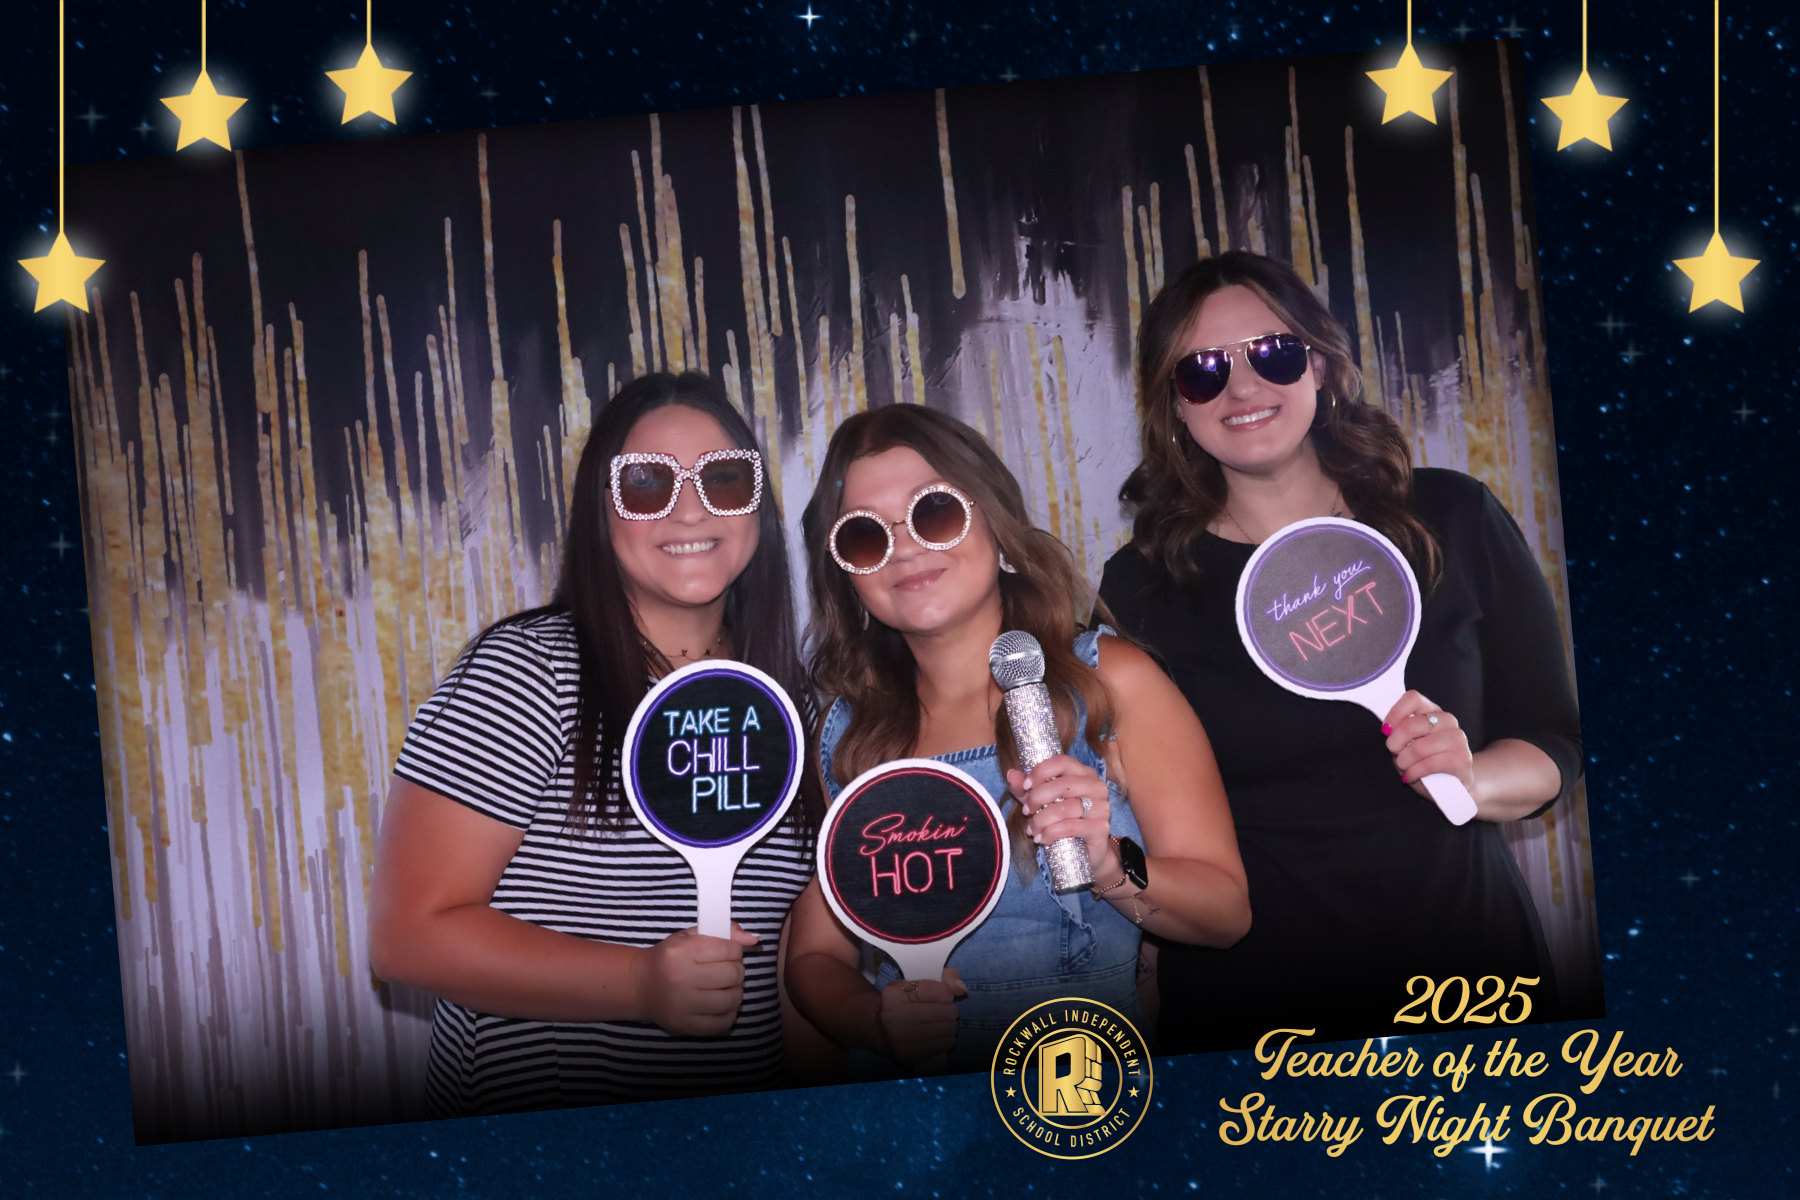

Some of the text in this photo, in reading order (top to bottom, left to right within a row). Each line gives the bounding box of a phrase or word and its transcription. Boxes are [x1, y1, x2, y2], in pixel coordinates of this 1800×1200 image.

[1265, 559, 1373, 622] thank you
[1288, 581, 1384, 662] NEXT
[662, 705, 762, 737] TAKE A
[667, 734, 761, 776] CHILL
[691, 773, 762, 814] PILL
[870, 847, 964, 898] HOT
